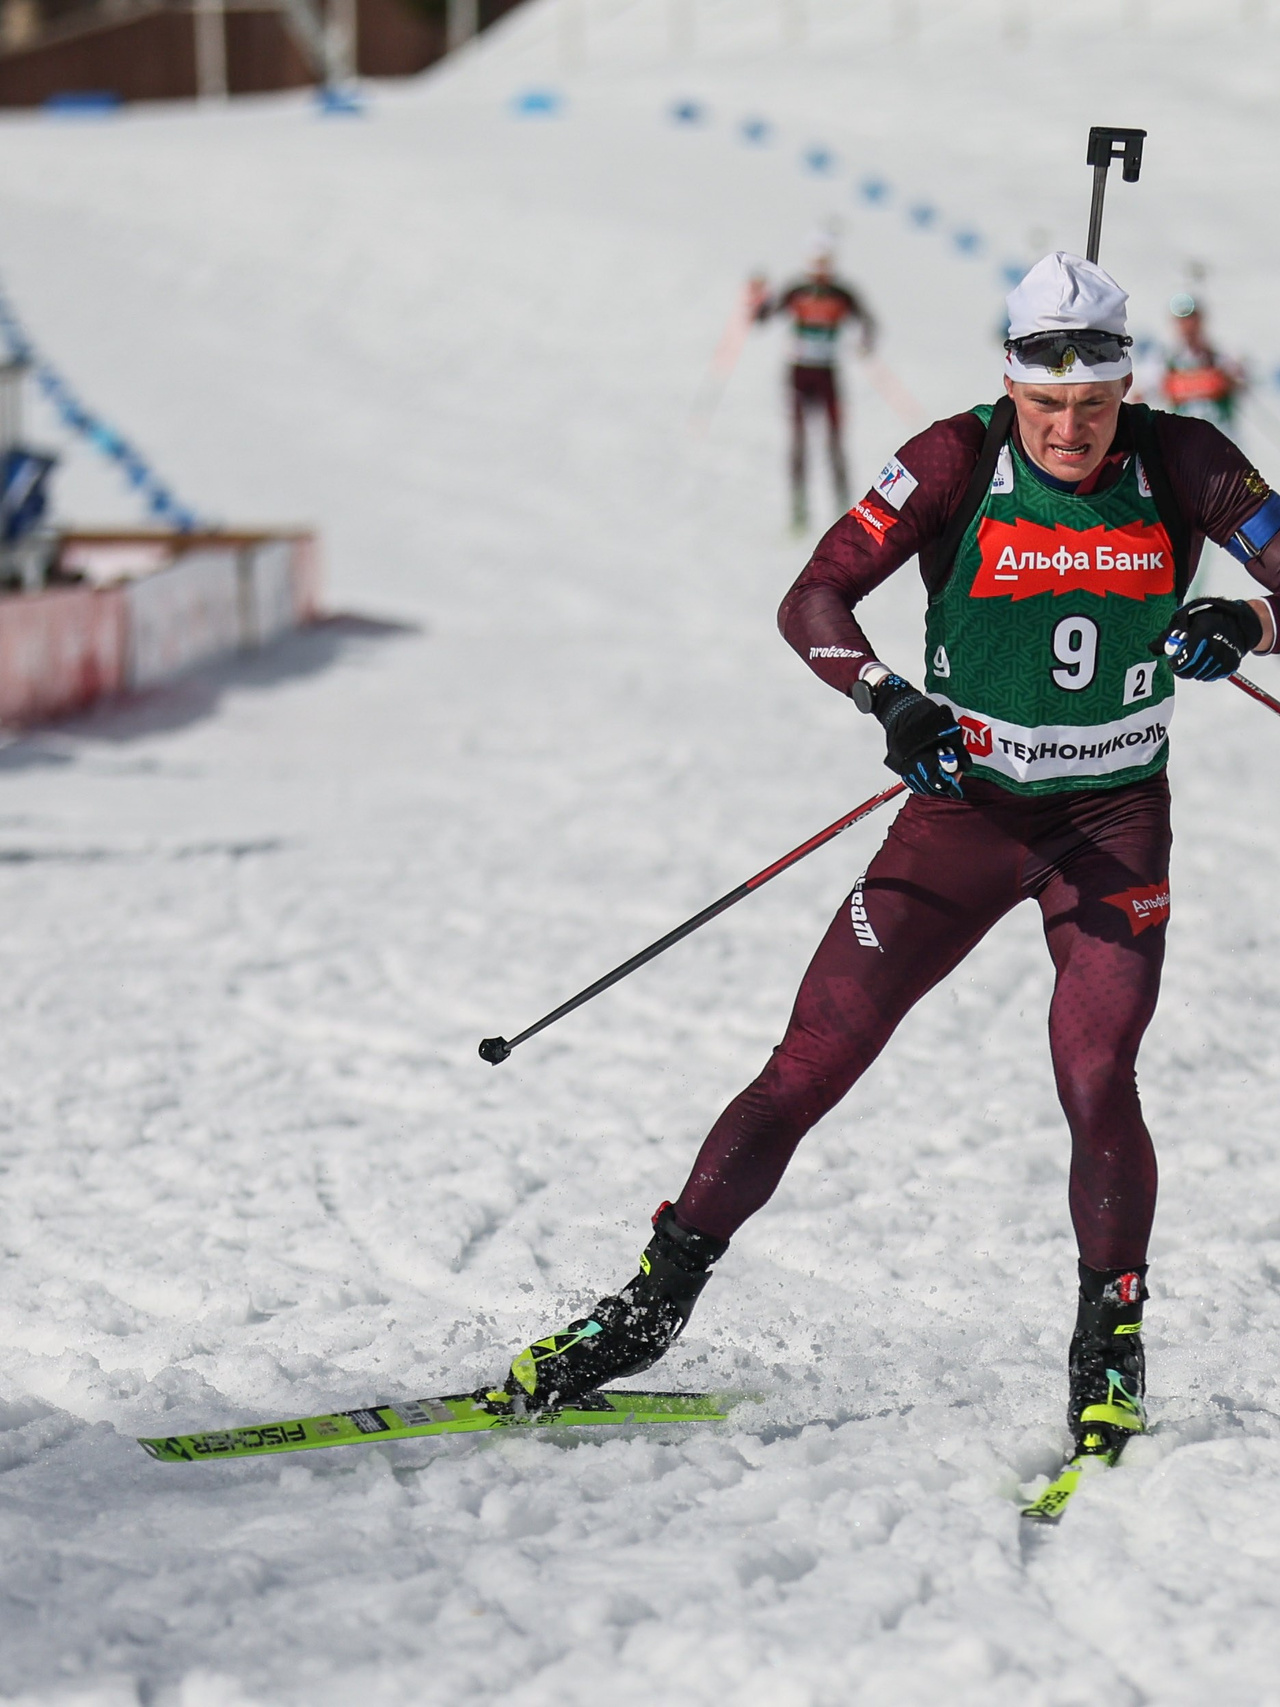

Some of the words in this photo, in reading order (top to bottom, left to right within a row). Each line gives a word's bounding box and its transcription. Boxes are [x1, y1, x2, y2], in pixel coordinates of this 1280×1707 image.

[995, 545, 1090, 577] Альфа
[1096, 546, 1164, 571] Банк
[933, 645, 951, 678] 9
[1051, 614, 1099, 691] 9
[1132, 669, 1147, 698] 2
[998, 722, 1167, 764] ТЕХНОНИКОЛЬ
[189, 1422, 307, 1454] FISCHER
